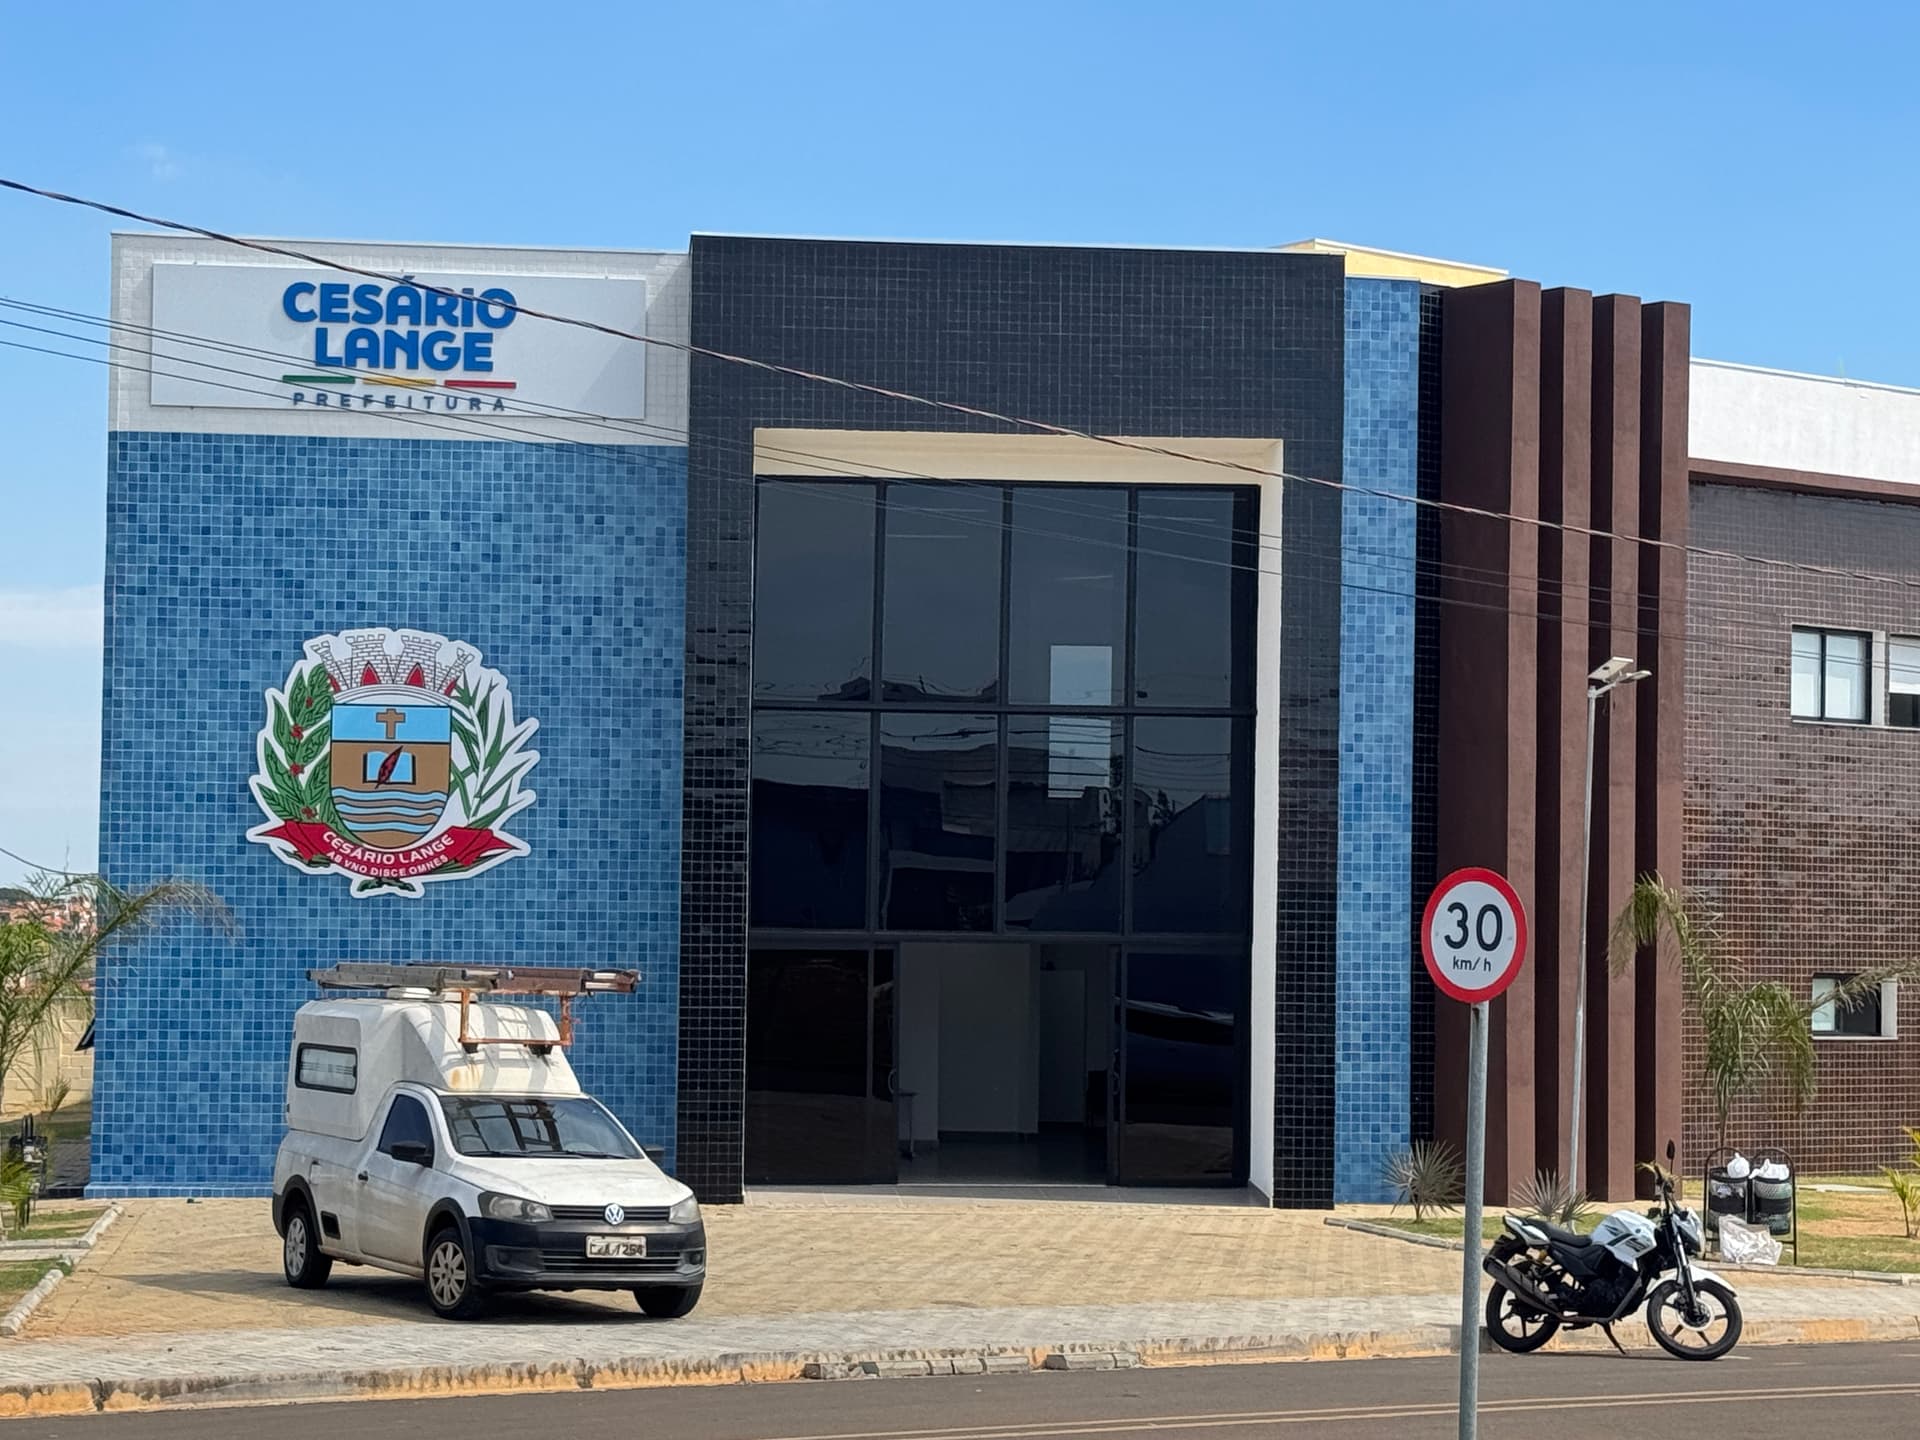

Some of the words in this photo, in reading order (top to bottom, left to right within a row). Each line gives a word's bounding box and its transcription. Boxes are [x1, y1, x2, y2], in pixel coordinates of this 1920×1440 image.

[283, 275, 517, 329] CESÁRIO
[315, 327, 493, 372] LANGE
[293, 392, 505, 412] PREFEITURA
[399, 834, 455, 863] LANGE
[326, 851, 343, 864] AB
[370, 867, 407, 878] DISCE
[408, 854, 449, 875] OMNES
[1444, 902, 1503, 951] 30
[1452, 956, 1492, 972] km/h
